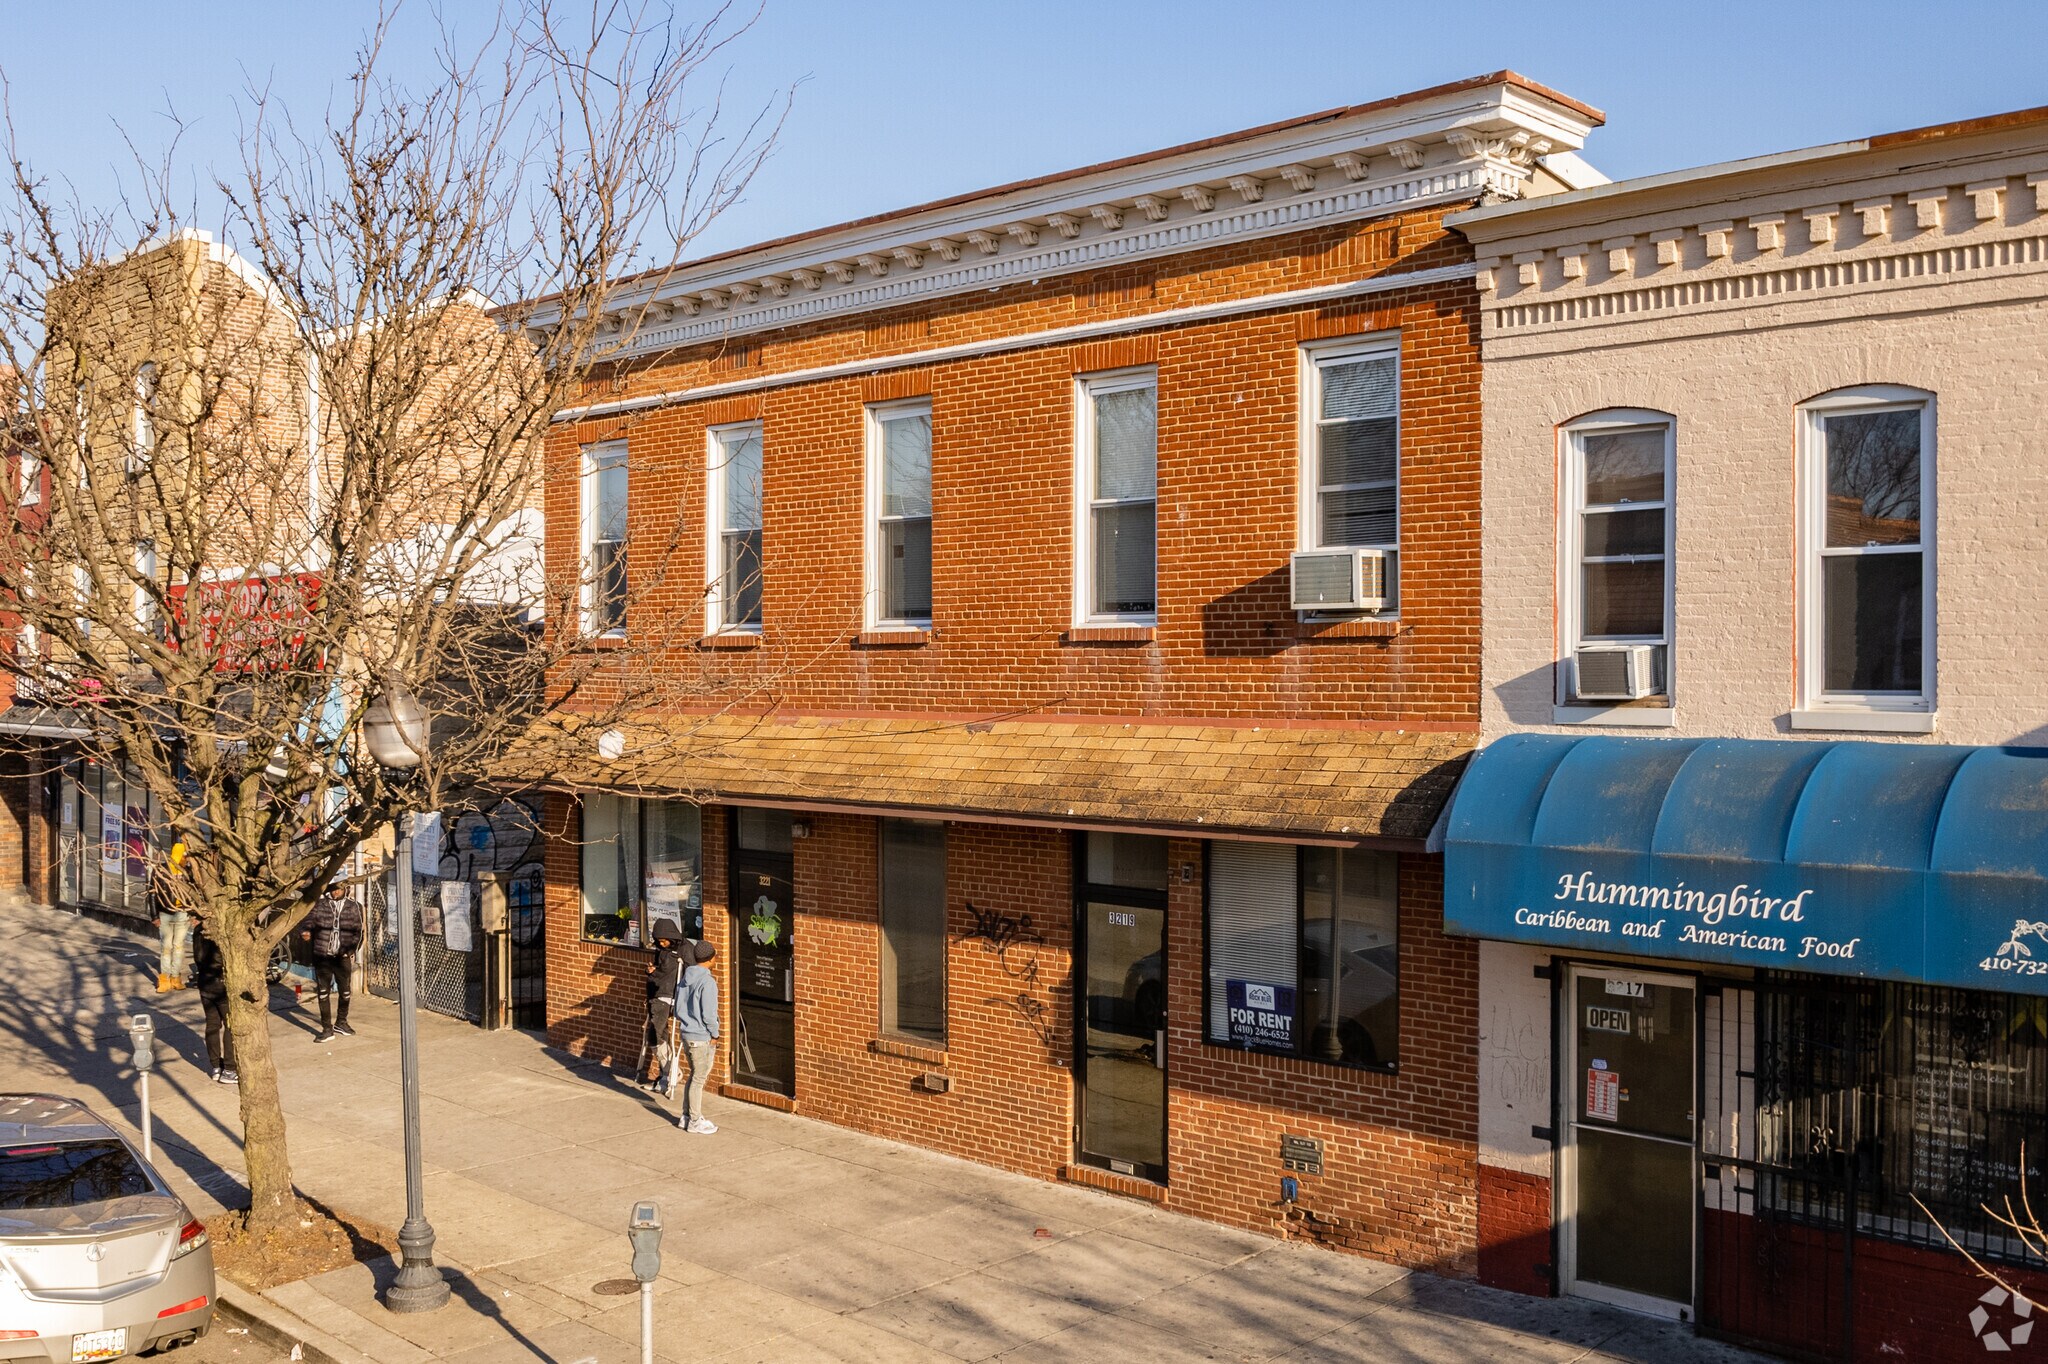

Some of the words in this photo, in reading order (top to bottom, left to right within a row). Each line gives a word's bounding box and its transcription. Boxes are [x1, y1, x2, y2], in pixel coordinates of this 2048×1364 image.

[1554, 870, 1814, 925] Hummingbird
[1109, 912, 1135, 926] 3219
[1515, 908, 1611, 934] Caribbean
[1622, 919, 1666, 938] and
[1679, 924, 1787, 952] American
[1798, 936, 1861, 959] Food
[1979, 957, 2048, 976] 410-732
[1230, 1007, 1256, 1026] FOR
[1258, 1011, 1292, 1031] RENT
[1590, 1008, 1627, 1031] OPEN
[1234, 1024, 1254, 1035] (410)
[1255, 1027, 1290, 1040] 246-6522
[1973, 1073, 2015, 1086] Chcken
